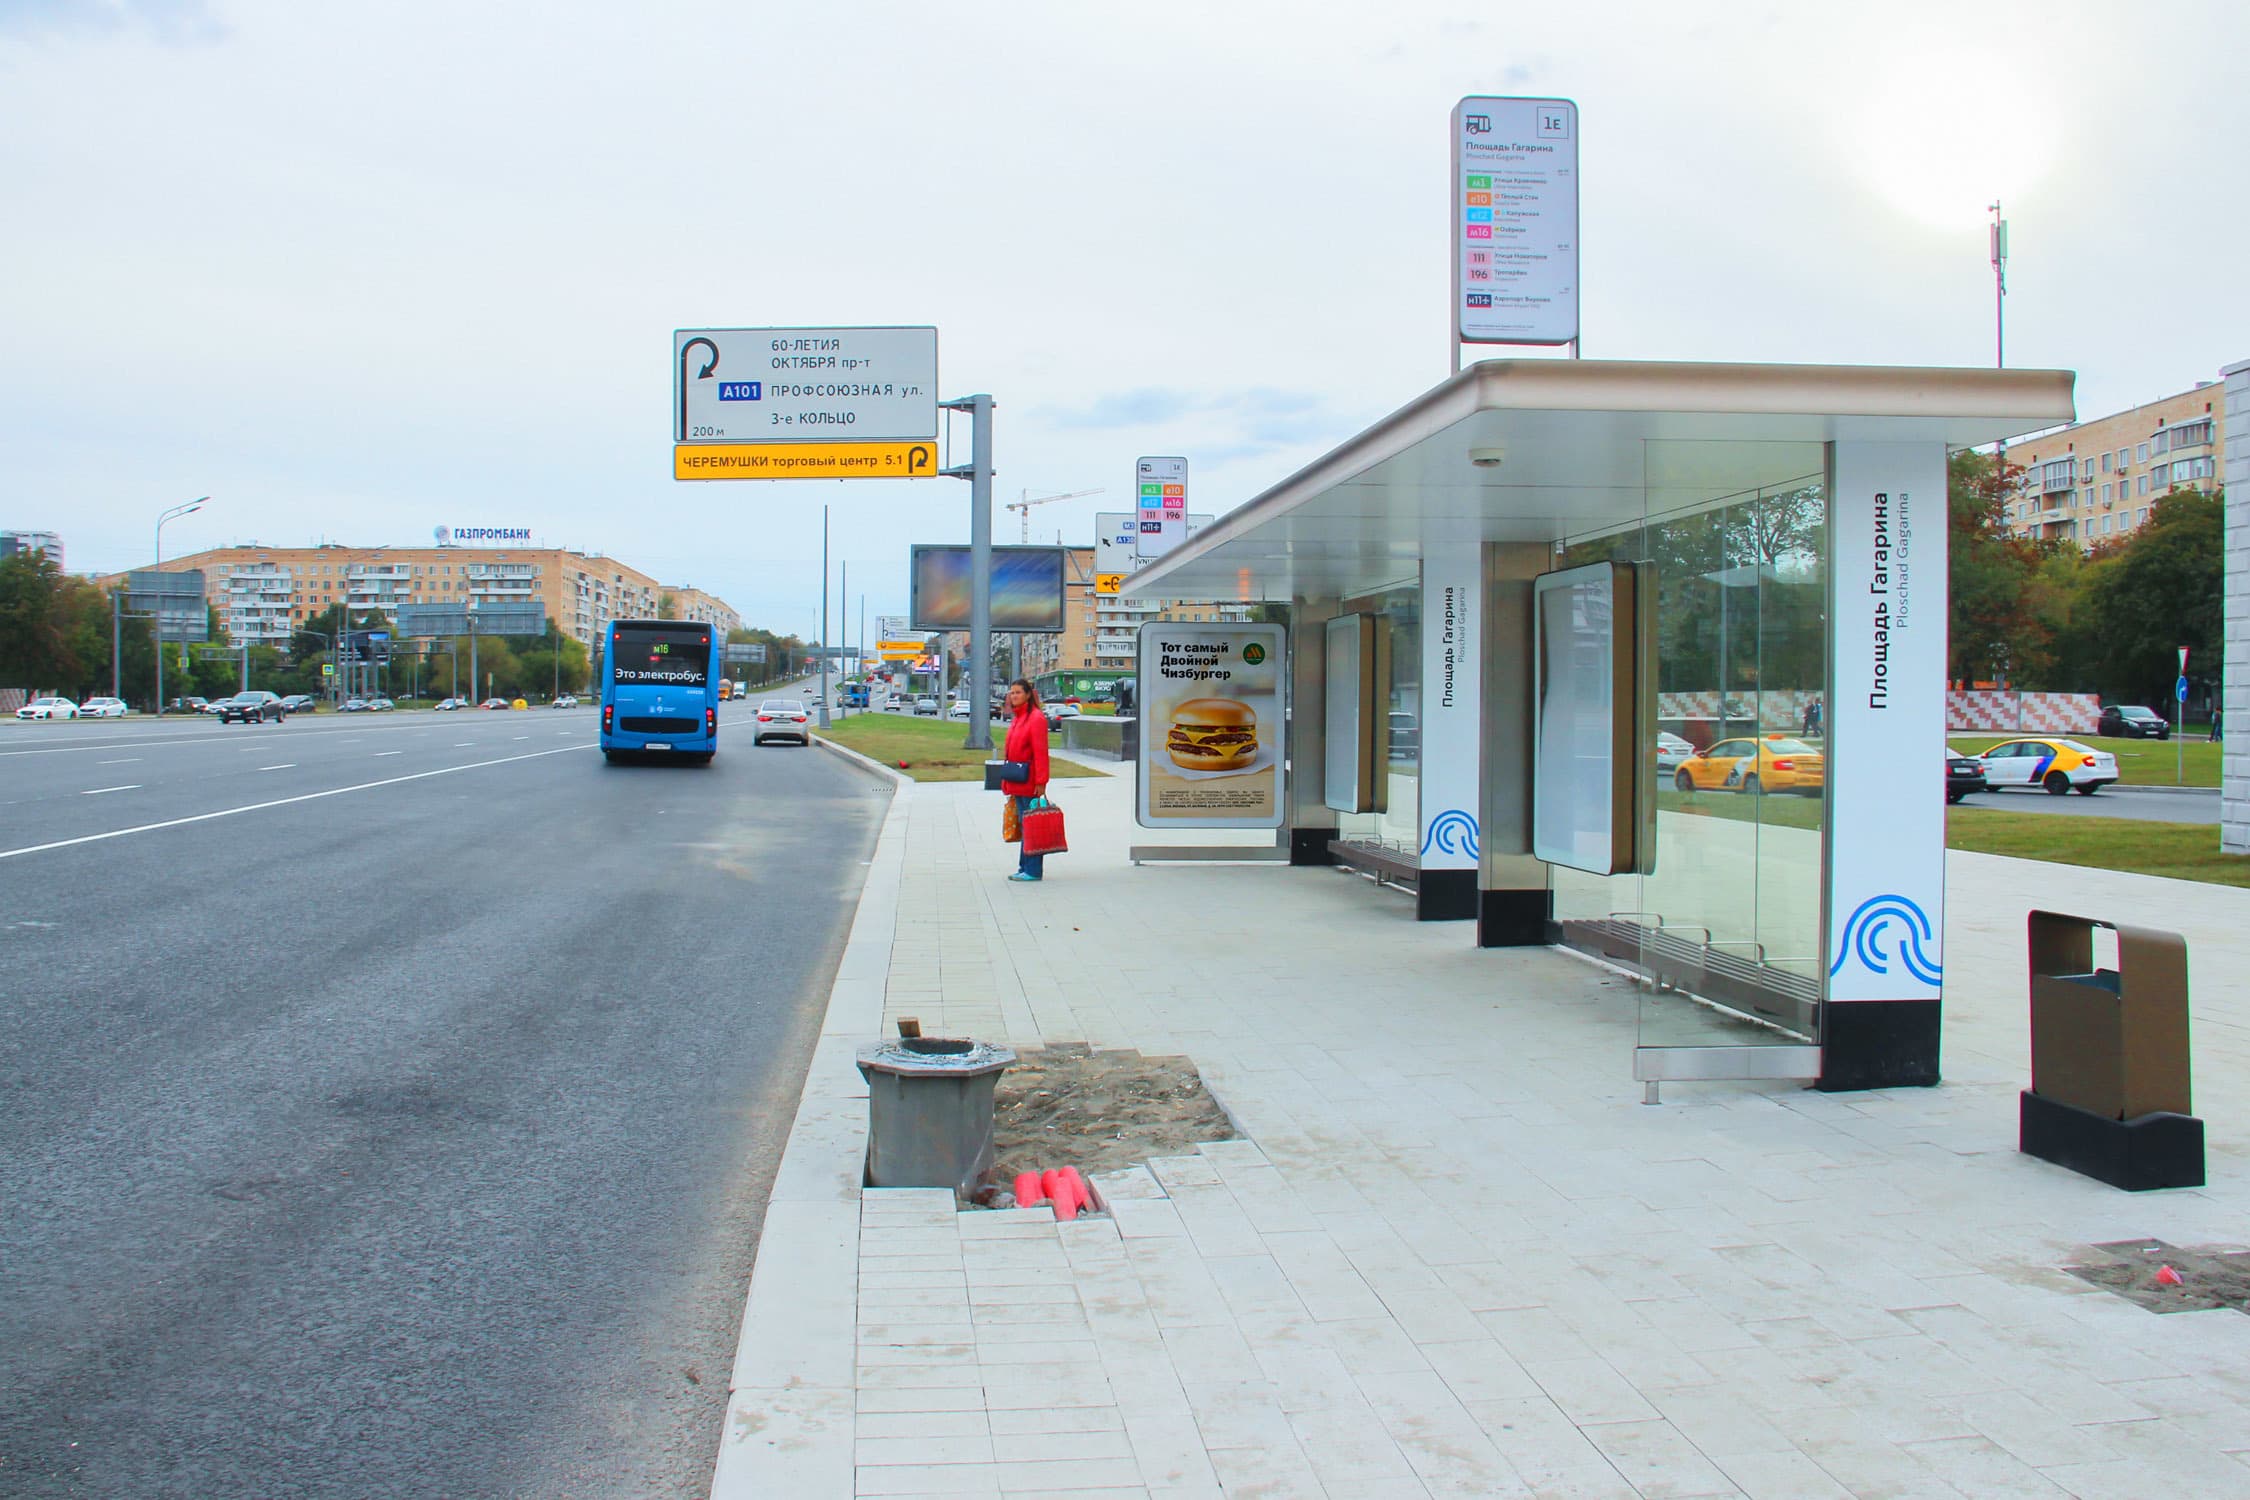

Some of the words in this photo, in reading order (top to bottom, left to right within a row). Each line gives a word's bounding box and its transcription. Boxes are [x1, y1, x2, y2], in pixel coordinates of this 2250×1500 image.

[1466, 142, 1510, 152] Площадь
[1512, 144, 1553, 152] Гагарина
[1470, 228, 1489, 236] м16
[1474, 253, 1485, 262] 111
[1471, 270, 1488, 279] 196
[771, 339, 840, 351] 60-ЛЕТИЯ
[771, 357, 836, 369] ОКТЯБРЯ
[842, 358, 872, 370] пр-т
[723, 385, 759, 398] А101
[770, 384, 893, 397] ПРОФСОЮЗНАЯ
[902, 386, 924, 399] ул.
[771, 413, 793, 425] 3-е
[800, 412, 856, 426] КОЛЬЦО
[692, 426, 714, 437] 200
[683, 456, 768, 468] ЧЕРЕМУШКИ
[772, 456, 836, 468] торговый
[840, 456, 878, 468] центр
[885, 454, 902, 465] 5.1
[1896, 493, 1911, 558] Gagarina
[454, 528, 530, 539] ГАЗПРОМБАНК
[1870, 492, 1892, 594] Гагарина
[1896, 563, 1909, 628] Ploschad
[1458, 587, 1467, 624] Gagarina
[1442, 587, 1455, 644] Гагарина
[1160, 642, 1182, 653] Тот
[1184, 642, 1229, 653] самый
[1160, 656, 1219, 667] Двойной
[1870, 602, 1890, 709] Площадь
[616, 668, 635, 679] Это
[638, 669, 705, 682] электробус.
[1160, 668, 1231, 680] Чизбургер
[1442, 648, 1454, 707] Площадь
